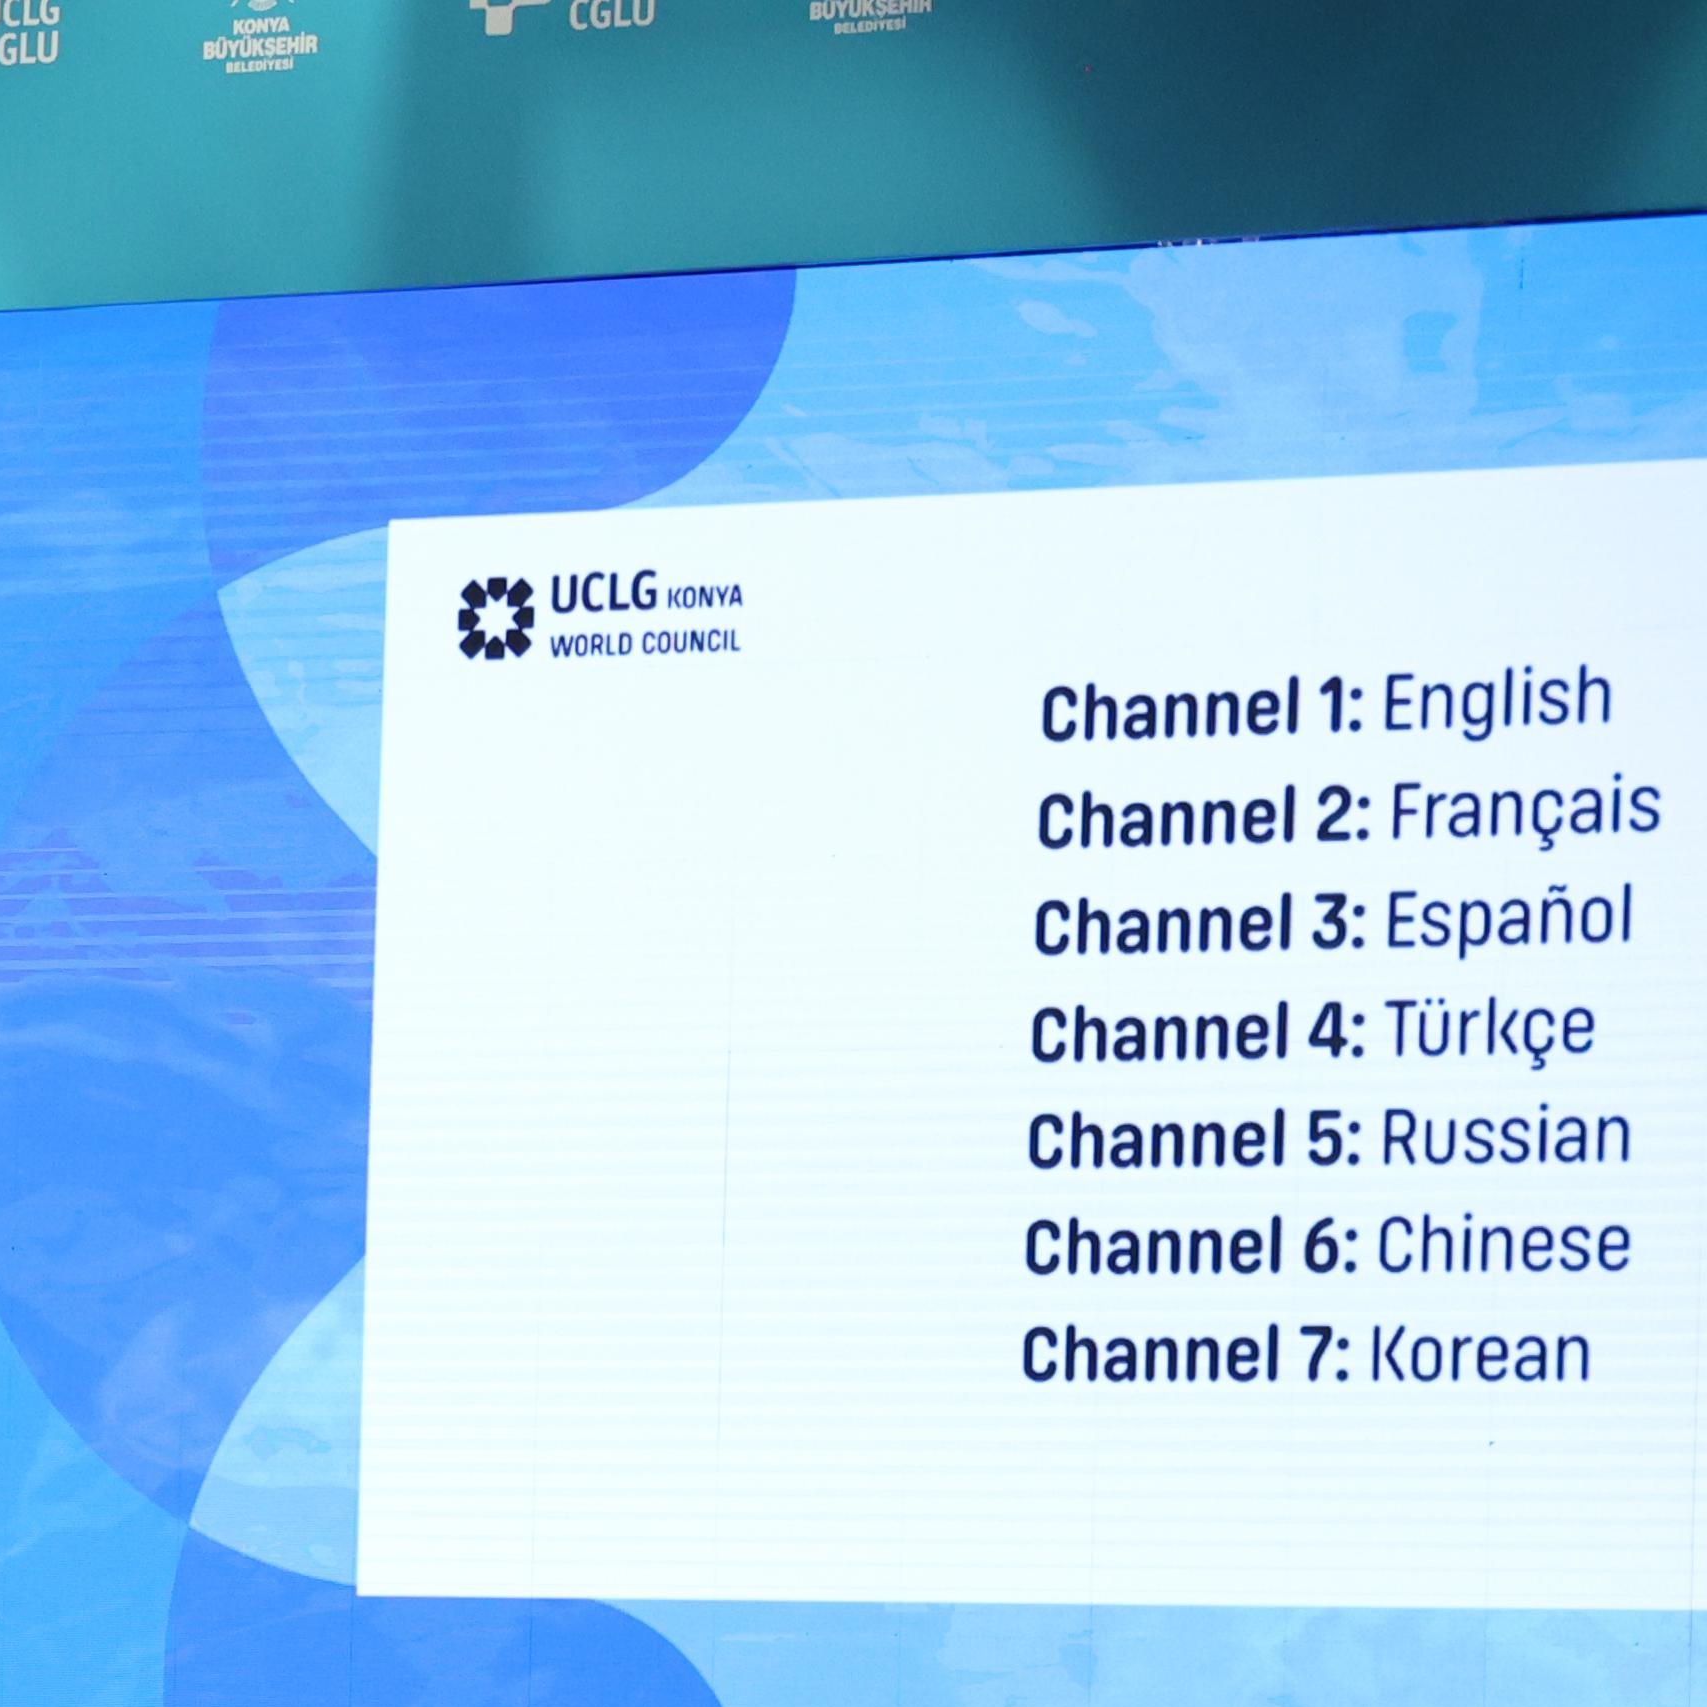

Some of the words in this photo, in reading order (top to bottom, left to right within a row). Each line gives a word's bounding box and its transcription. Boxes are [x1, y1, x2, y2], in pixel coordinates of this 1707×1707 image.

[234, 17, 289, 35] KONYA
[570, 0, 655, 30] CGLU
[552, 570, 657, 613] UCLG
[668, 584, 742, 608] KONYA
[551, 633, 632, 658] WORLD
[642, 629, 740, 654] COUNCIL
[1043, 676, 1299, 741] Channel
[1320, 676, 1362, 732] 1:
[1386, 664, 1610, 741] English
[1039, 784, 1295, 849] Channel
[1317, 785, 1370, 841] 2:
[1393, 773, 1660, 851] Français
[1036, 892, 1291, 955] Channel
[1313, 893, 1365, 949] 3:
[1388, 883, 1631, 959] Español
[1032, 1001, 1288, 1063] Channel
[1309, 1002, 1364, 1058] 4:
[1385, 997, 1594, 1070] Türkçe
[1029, 1108, 1284, 1169] Channel
[1309, 1110, 1360, 1166] 5:
[1384, 1103, 1629, 1165] Russian
[1026, 1215, 1281, 1275] Channel
[1305, 1217, 1357, 1273] 6:
[1380, 1213, 1629, 1273] Chinese
[1024, 1323, 1278, 1382] Channel
[1300, 1326, 1349, 1381] 7:
[1373, 1325, 1588, 1382] Korean
